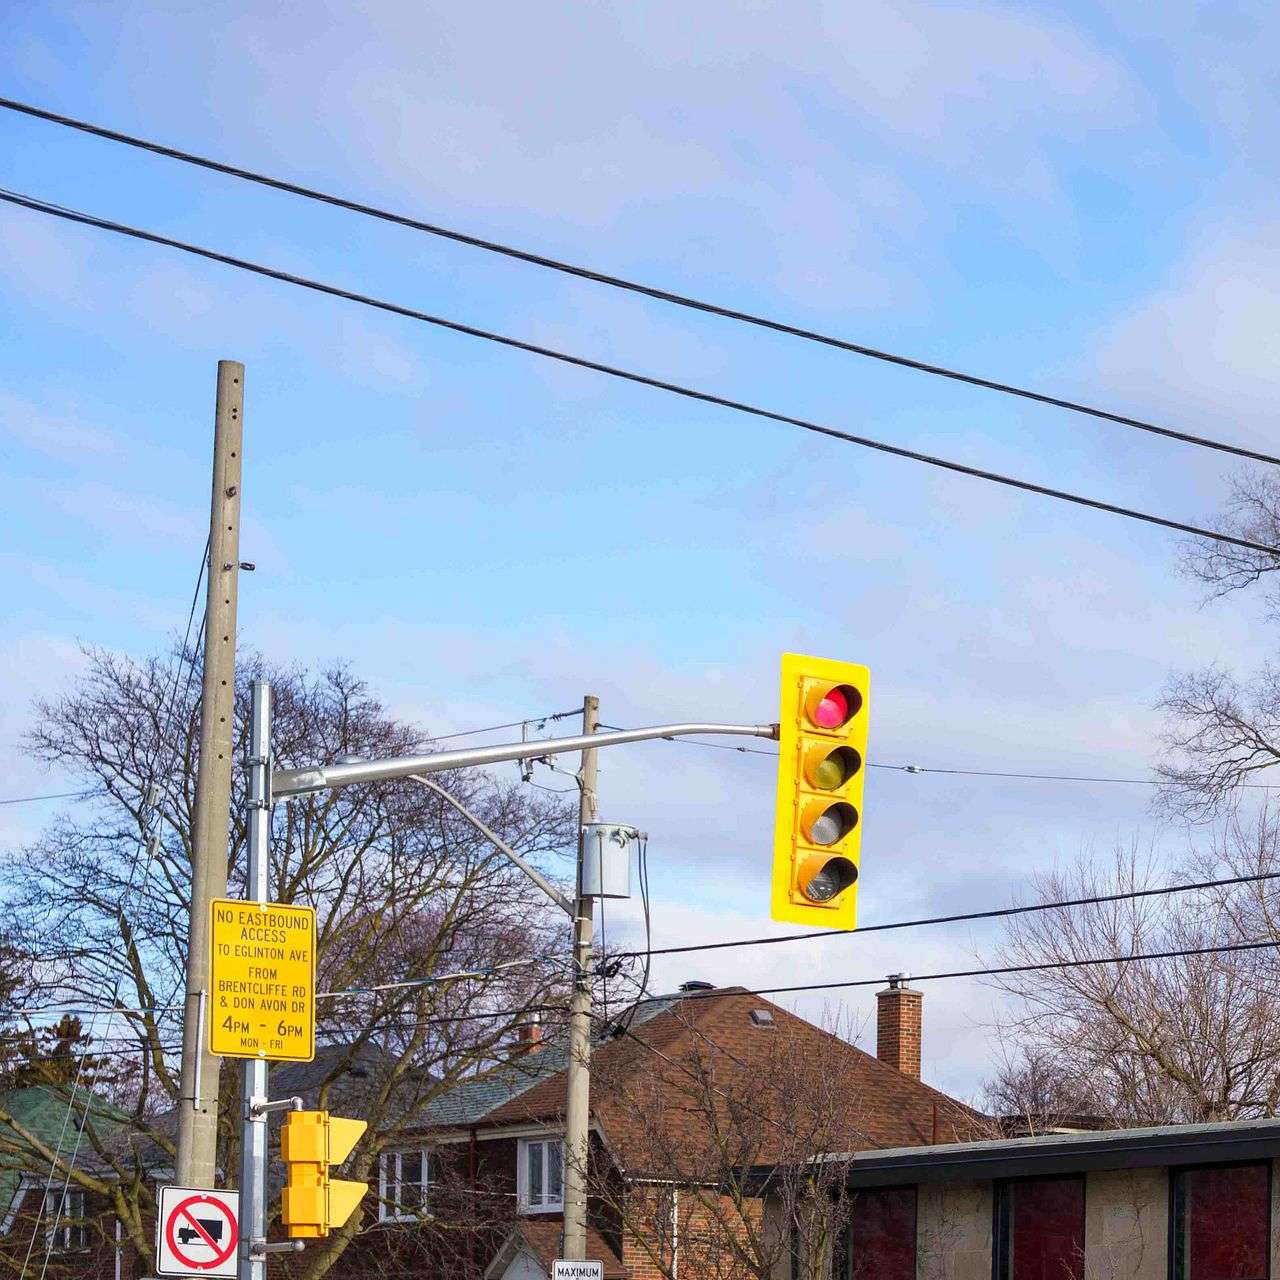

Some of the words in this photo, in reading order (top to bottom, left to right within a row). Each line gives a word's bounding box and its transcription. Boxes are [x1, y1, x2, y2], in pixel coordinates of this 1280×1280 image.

[217, 909, 233, 924] NO
[239, 911, 309, 930] EASTBOUND
[241, 928, 286, 943] ACCESS
[218, 943, 229, 956] TO
[235, 945, 284, 960] EGLINTON
[289, 950, 308, 962] AVE
[248, 967, 277, 980] FROM
[218, 980, 288, 997] BRENTCLIFFE
[292, 985, 306, 998] RD
[220, 996, 228, 1008] &
[233, 997, 255, 1009] DON
[260, 999, 287, 1012] AVON
[291, 1001, 305, 1013] DR
[222, 1015, 250, 1033] 4PM
[277, 1020, 303, 1037] 6PM
[240, 1038, 259, 1048] MON
[270, 1040, 283, 1049] FRI
[557, 1267, 599, 1278] MAXIMUM
